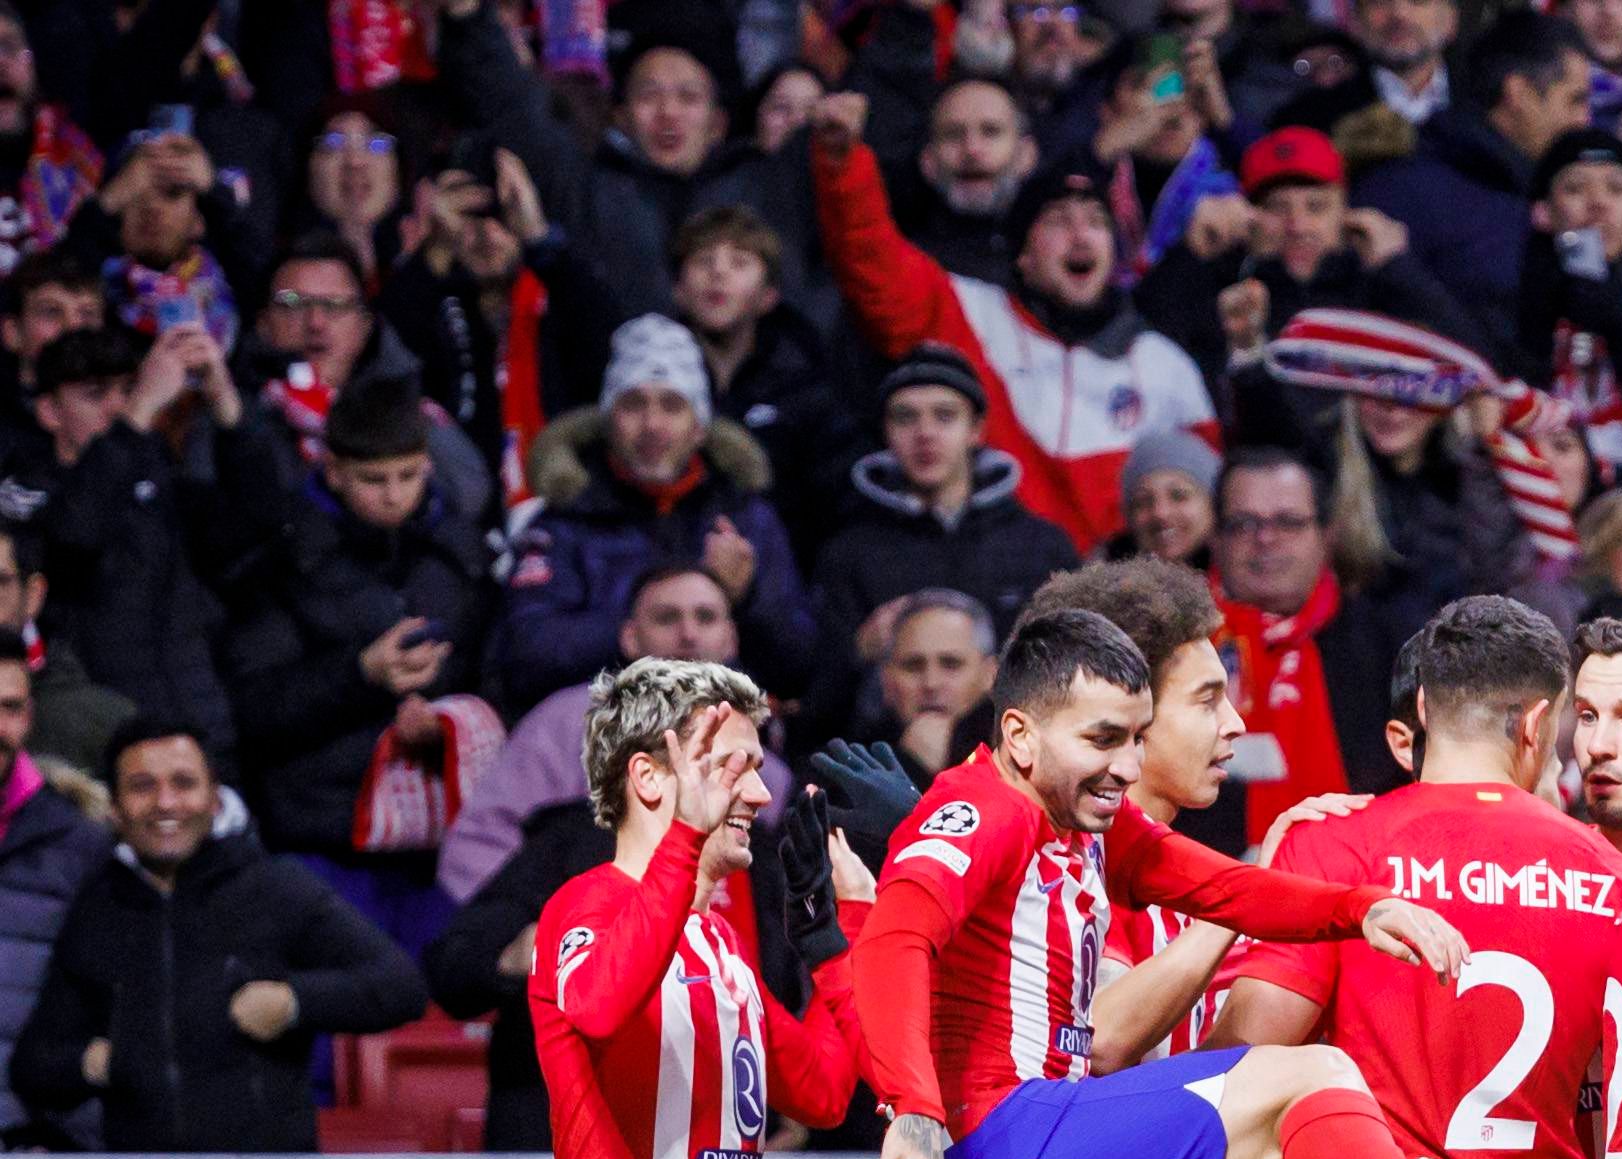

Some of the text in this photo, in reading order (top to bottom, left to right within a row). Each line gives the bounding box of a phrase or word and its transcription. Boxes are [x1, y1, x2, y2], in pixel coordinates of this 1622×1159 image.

[1388, 856, 1452, 900] J.M.
[1458, 858, 1616, 917] GIMÉNEZ
[1443, 950, 1555, 1151] 2
